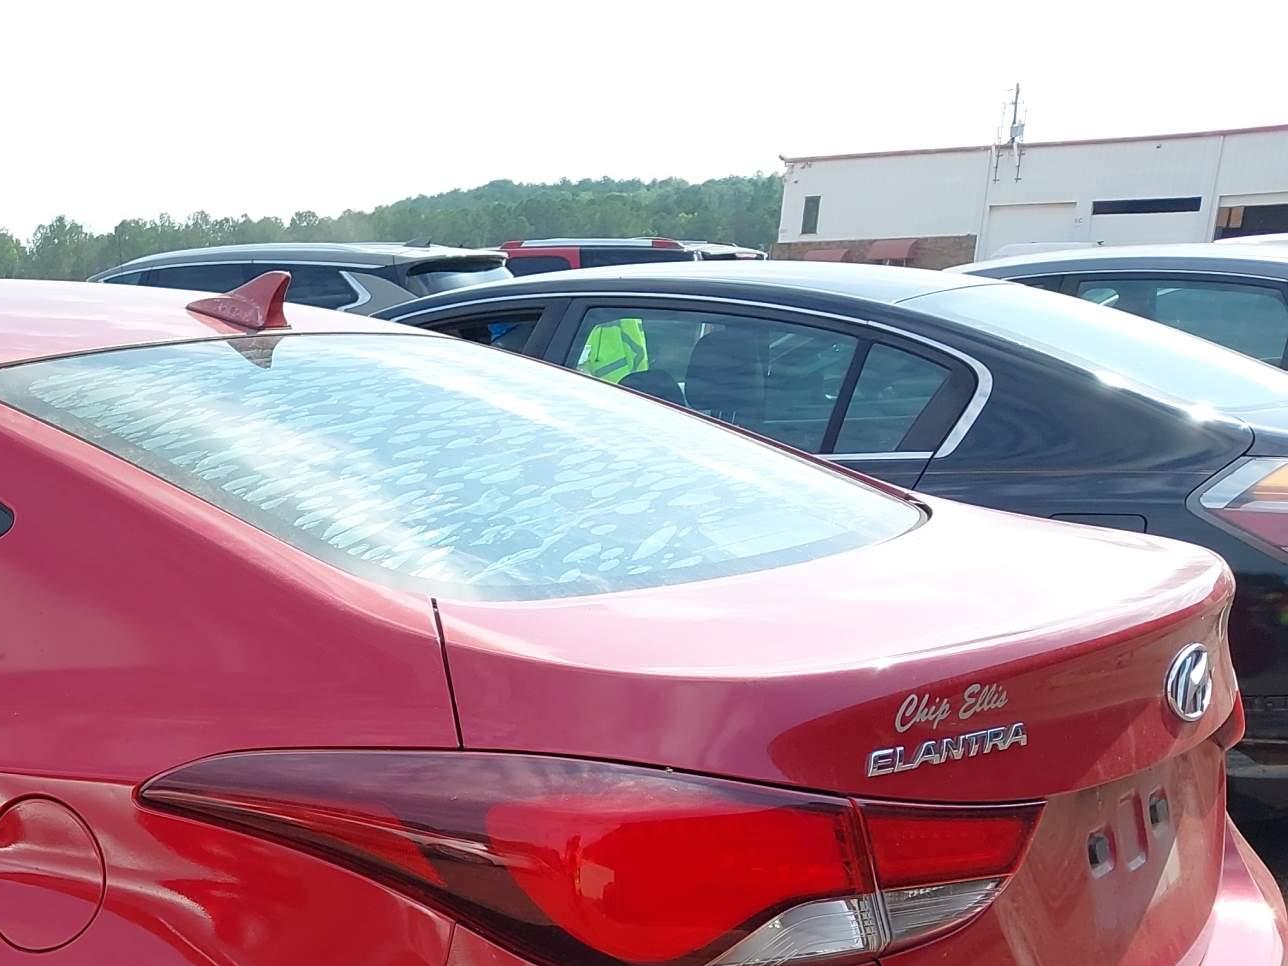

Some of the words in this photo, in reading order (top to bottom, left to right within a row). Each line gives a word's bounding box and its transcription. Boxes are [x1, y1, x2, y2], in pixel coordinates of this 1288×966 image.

[894, 693, 952, 733] Chip
[958, 683, 1009, 720] Ellis
[866, 722, 1028, 777] ELANTRA
